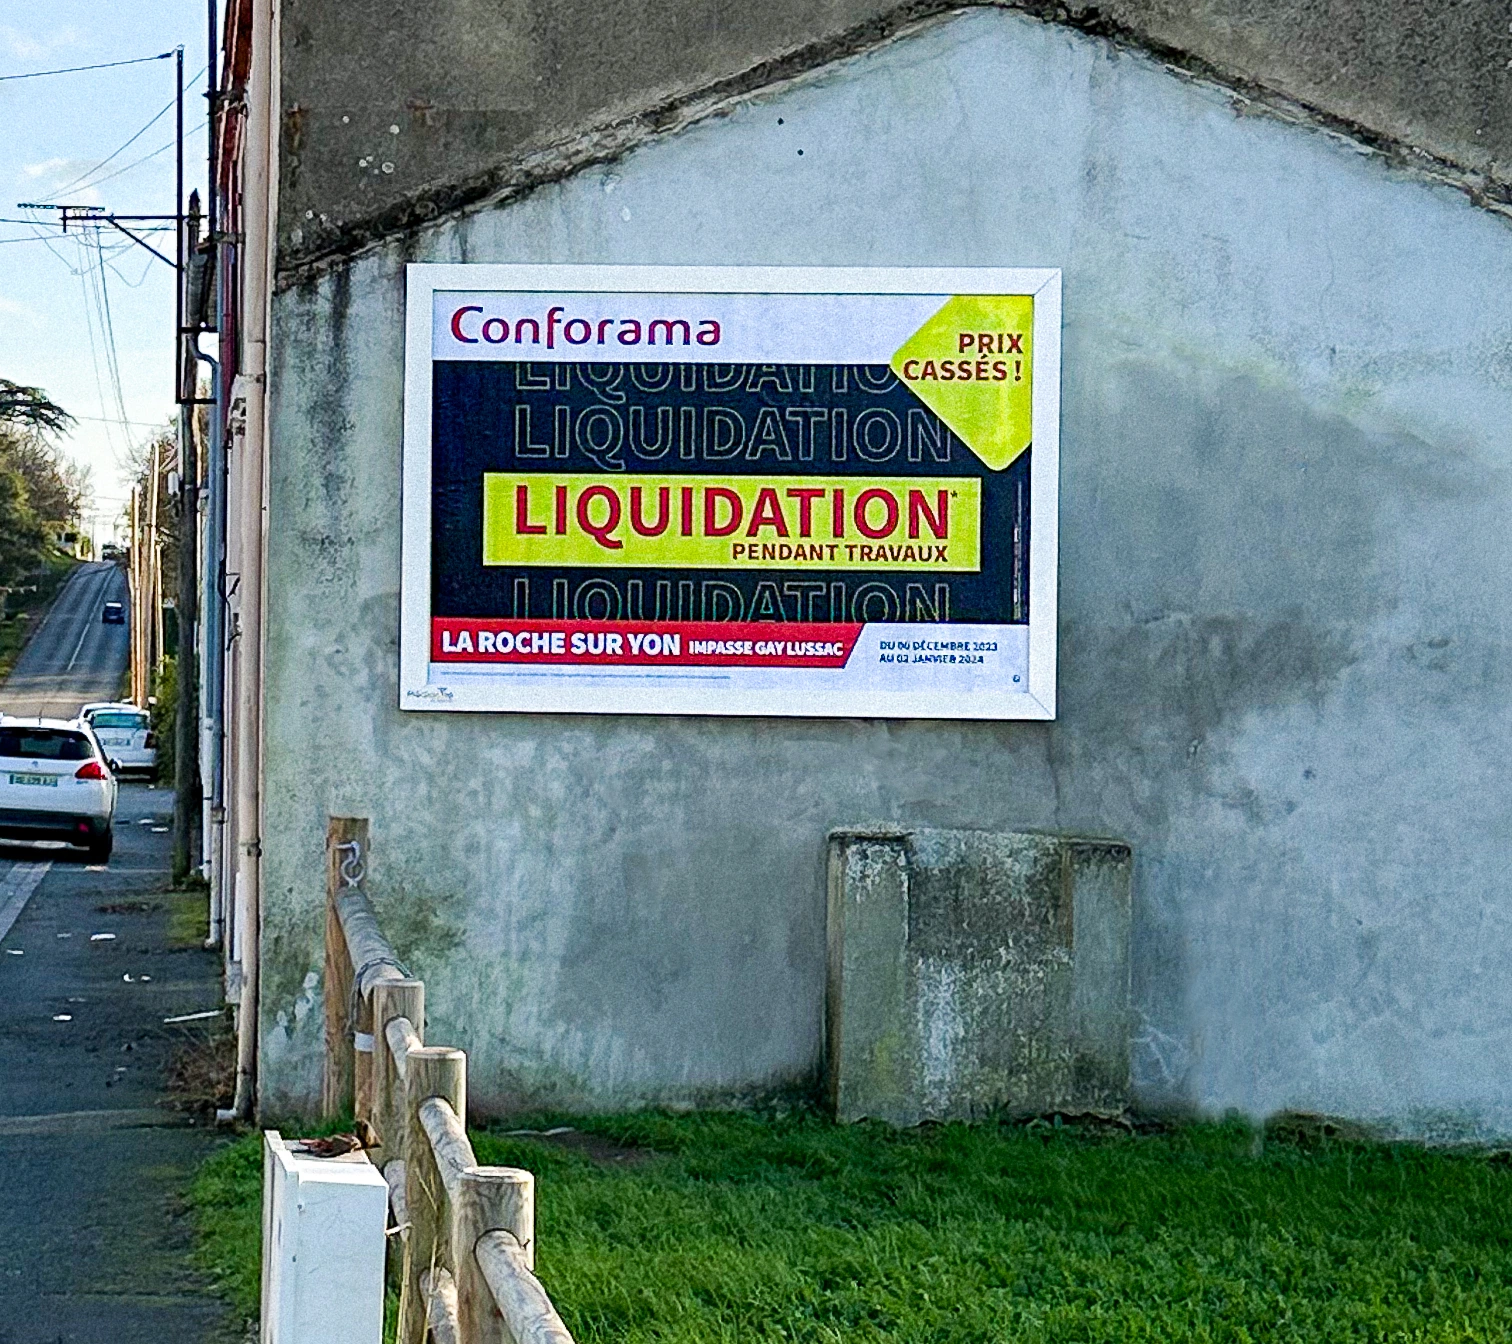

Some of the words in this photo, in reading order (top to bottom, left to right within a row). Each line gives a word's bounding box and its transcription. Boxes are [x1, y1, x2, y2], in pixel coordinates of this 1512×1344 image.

[451, 306, 721, 349] Conforama
[958, 333, 1023, 354] PRIX
[903, 354, 1008, 381] CASSÉS
[515, 362, 900, 404] LIQUIDATIO
[515, 405, 950, 471] LIQUIDATION
[732, 543, 839, 560] PENDANT
[845, 545, 948, 562] TRAVAUX
[442, 630, 473, 652] LA
[478, 632, 565, 654] ROCHE
[571, 633, 624, 654] SUR
[627, 633, 681, 655] YON
[689, 640, 753, 655] IMPASSE
[755, 641, 786, 655] GAY
[787, 642, 843, 656] LUSSAC
[879, 641, 895, 650] DU
[879, 654, 895, 663] AU
